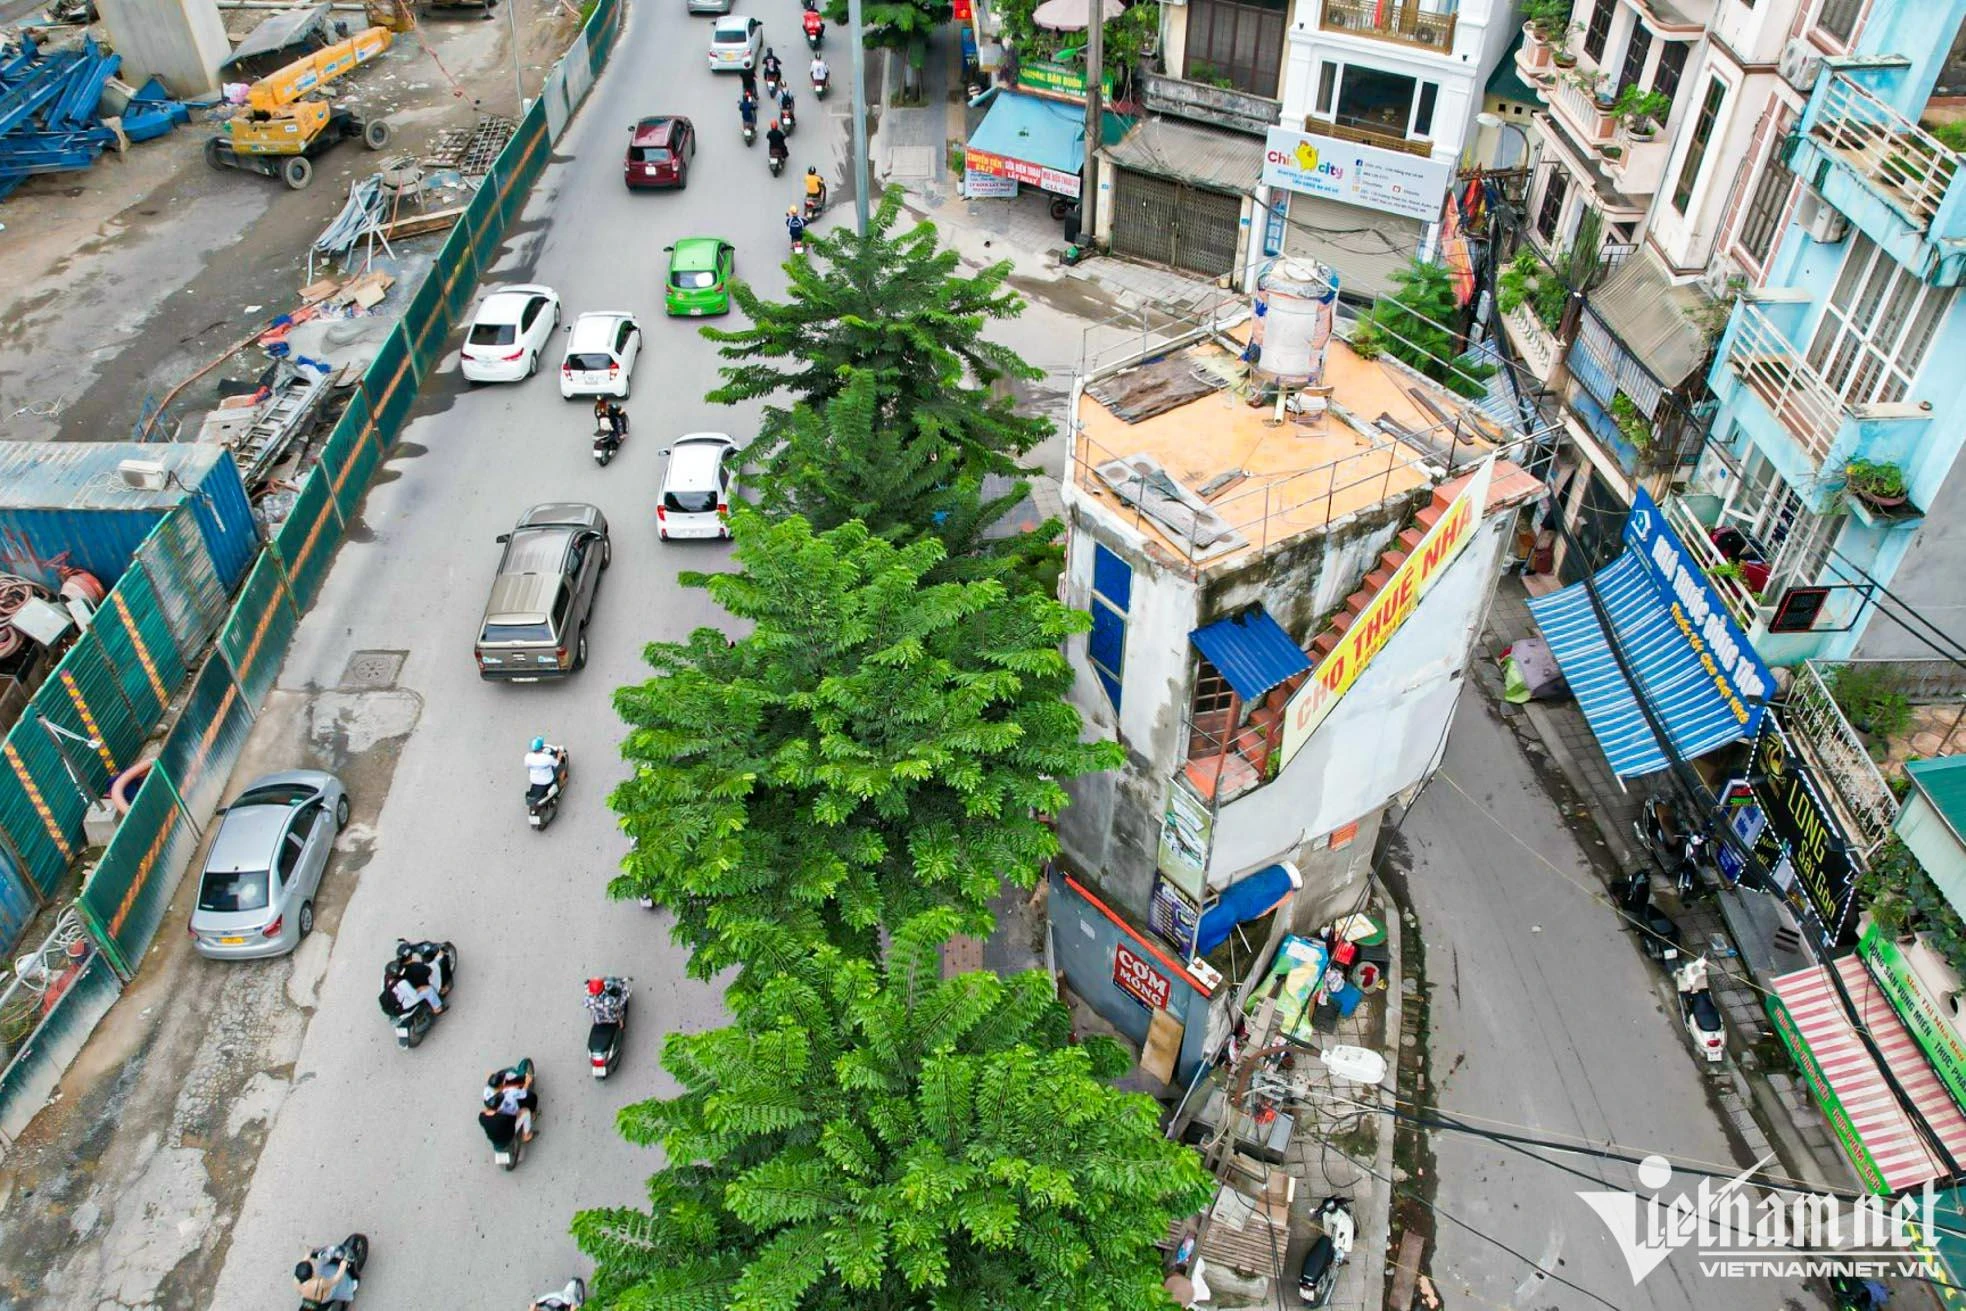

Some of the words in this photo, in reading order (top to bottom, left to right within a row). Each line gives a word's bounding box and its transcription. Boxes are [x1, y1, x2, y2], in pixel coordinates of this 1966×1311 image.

[1318, 161, 1344, 179] city
[1297, 656, 1345, 731] CHO
[1353, 565, 1416, 660] THUÊ
[1788, 779, 1829, 863] LONG
[1815, 870, 1836, 919] Gòn
[1118, 950, 1167, 996] CƠM
